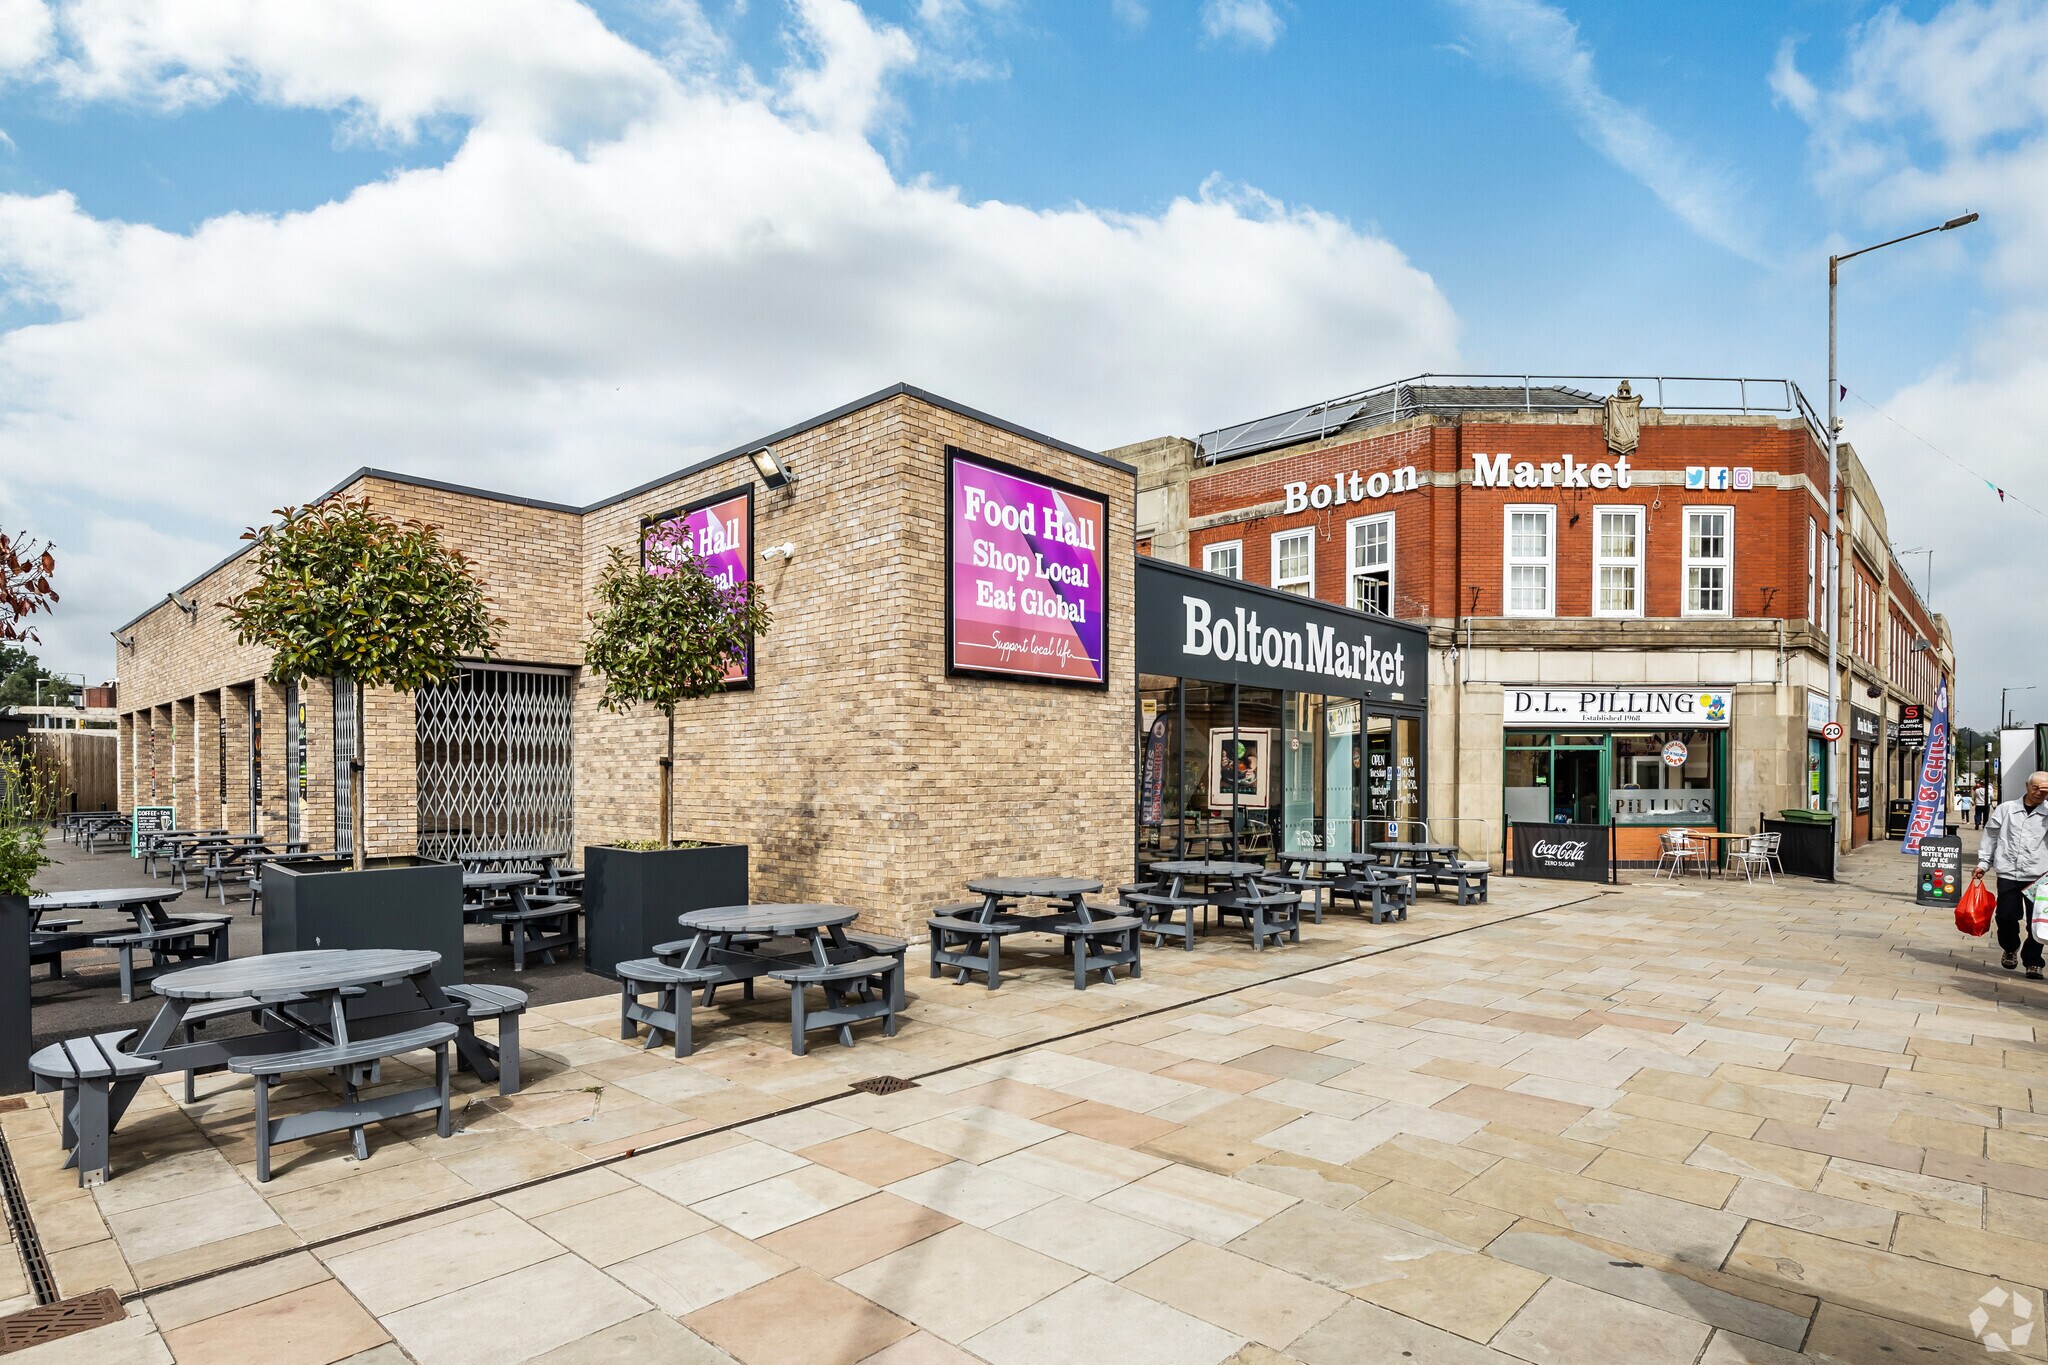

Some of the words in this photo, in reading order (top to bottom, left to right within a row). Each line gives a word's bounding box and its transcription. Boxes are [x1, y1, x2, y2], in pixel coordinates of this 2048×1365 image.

[1283, 465, 1419, 515] Bolton
[1472, 453, 1631, 489] Market
[964, 484, 1036, 537] Food
[1042, 506, 1096, 551] Hall
[699, 518, 740, 558] Hall
[973, 540, 1030, 582] Shop
[1034, 551, 1089, 588] Local
[713, 564, 735, 591] cal
[976, 579, 1017, 612] Eat
[1020, 588, 1086, 623] Global
[989, 630, 1030, 662] Support
[1030, 632, 1054, 657] local
[1054, 638, 1077, 668] life
[1515, 691, 1567, 713] D.L.
[1578, 692, 1695, 714] PILLING
[1825, 727, 1840, 736] 20
[1154, 743, 1164, 780] CHIPS
[1371, 754, 1385, 766] OPEN
[1401, 757, 1414, 767] OPEN
[1665, 755, 1683, 765] OPEN
[1142, 749, 1154, 822] PILLINGS
[1369, 768, 1386, 780] Tuesday
[1152, 795, 1162, 821] FISH
[1615, 798, 1712, 814] PILLINGS
[1532, 839, 1588, 860] Coca-Cola
